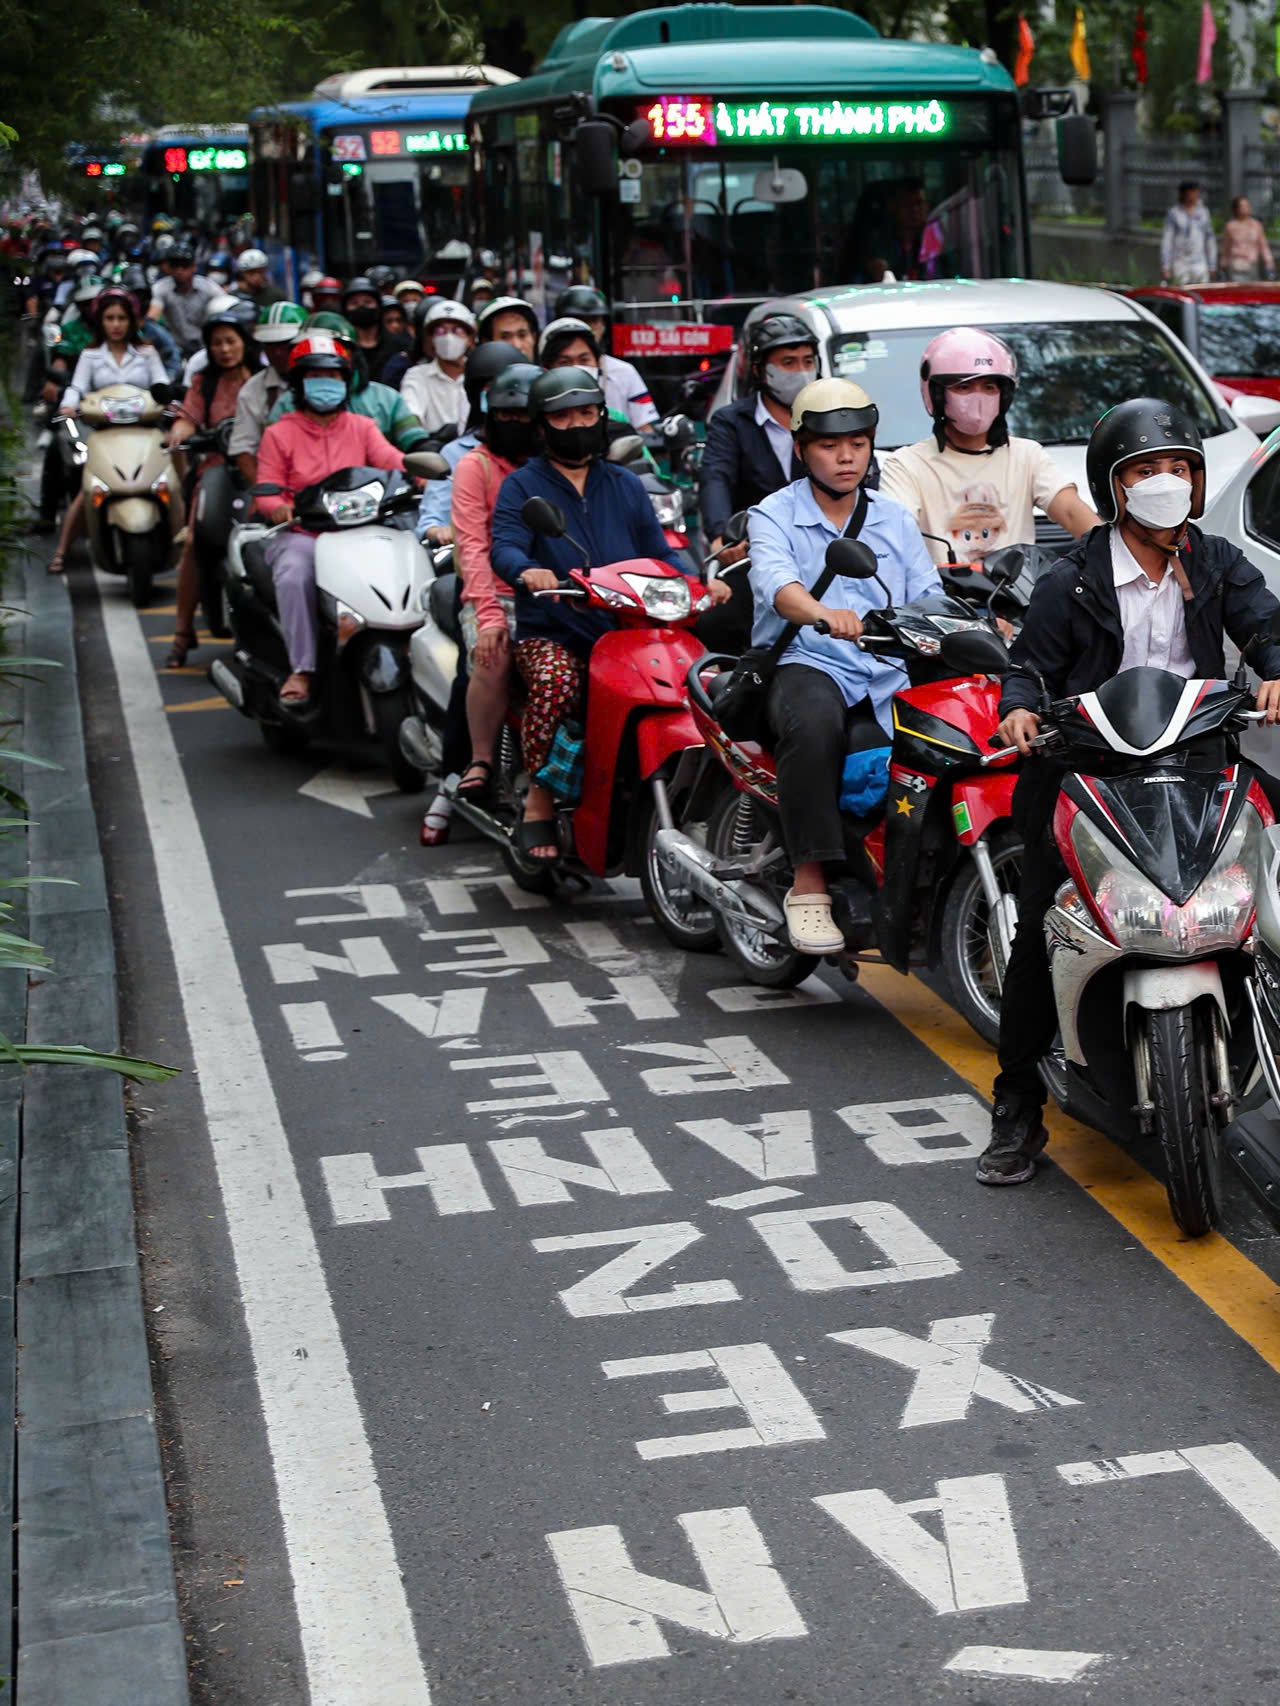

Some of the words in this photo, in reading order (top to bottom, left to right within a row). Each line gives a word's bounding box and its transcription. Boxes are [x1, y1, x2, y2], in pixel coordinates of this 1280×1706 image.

[647, 103, 706, 138] 155
[370, 130, 400, 155] 52
[1143, 775, 1186, 784] HONDA
[320, 1093, 994, 1226] BÁNH
[601, 1313, 1084, 1460] XE
